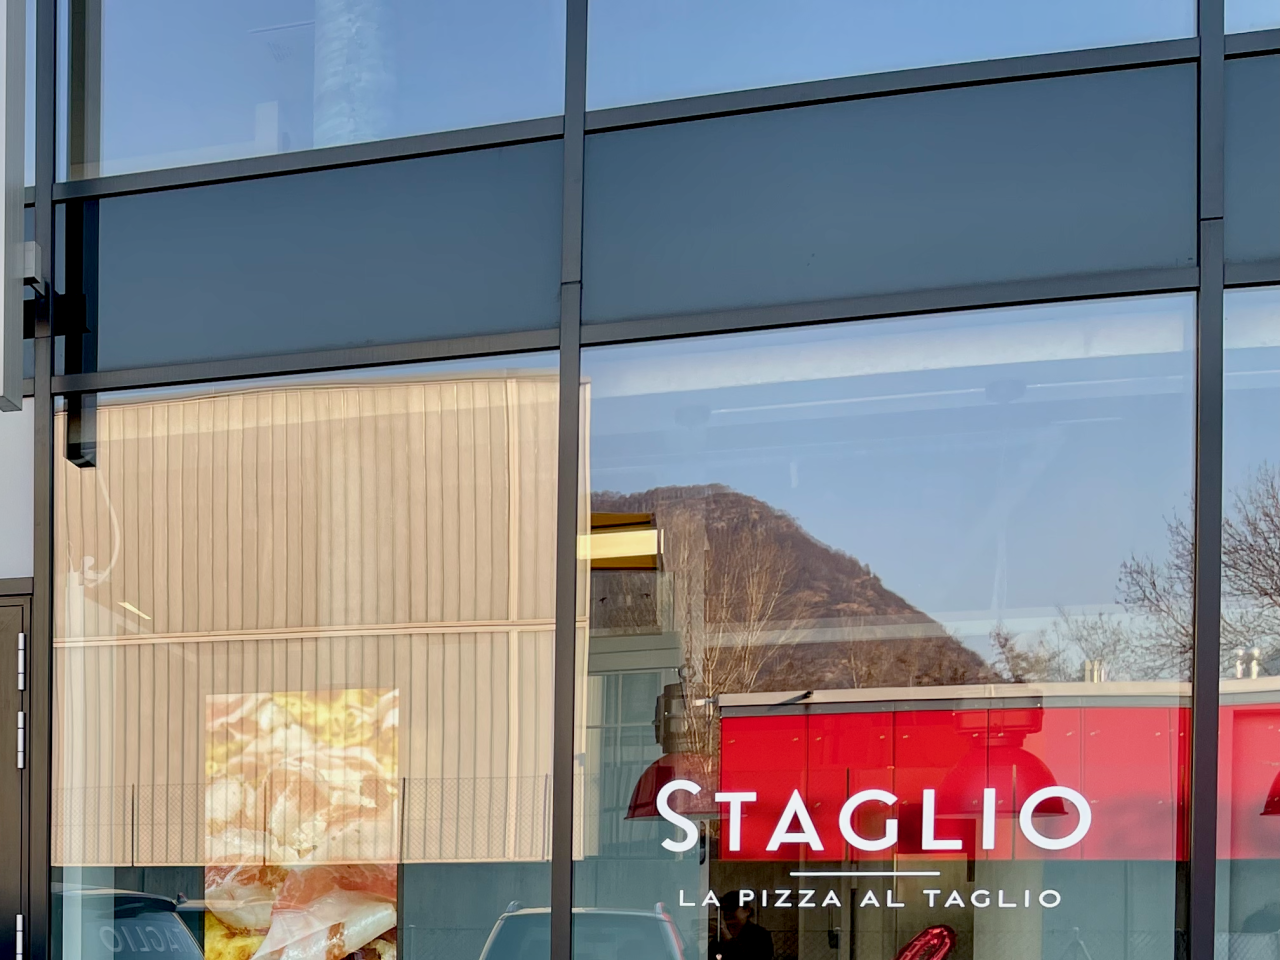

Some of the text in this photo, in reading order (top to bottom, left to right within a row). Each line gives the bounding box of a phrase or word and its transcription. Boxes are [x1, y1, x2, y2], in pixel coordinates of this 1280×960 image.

[656, 779, 1092, 852] STAGLIO
[679, 889, 1062, 908] LA PIZZA AL TAGLIO
